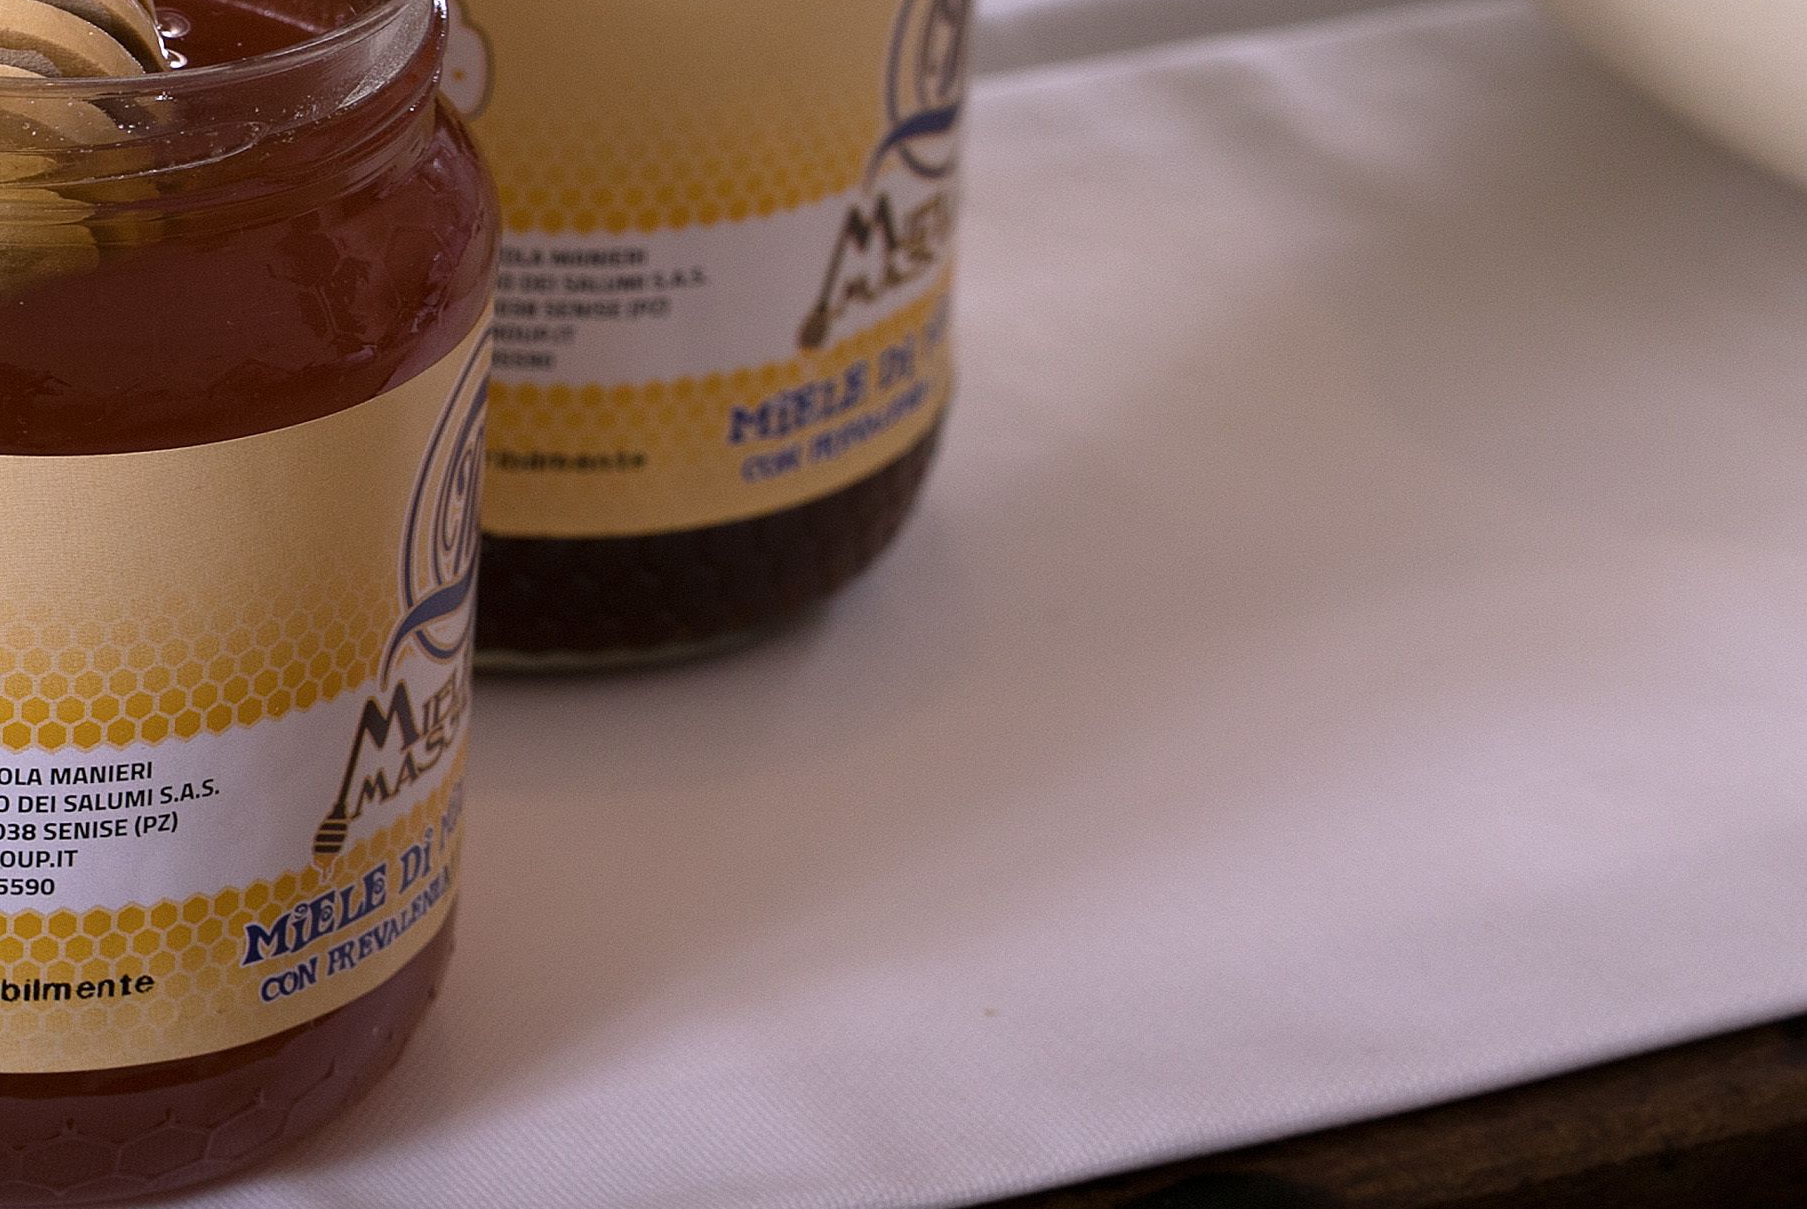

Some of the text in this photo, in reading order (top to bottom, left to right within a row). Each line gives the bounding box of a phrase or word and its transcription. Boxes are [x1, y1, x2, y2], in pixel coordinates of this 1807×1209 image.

[49, 760, 154, 786] MANIERI
[17, 794, 57, 814] DEI
[63, 788, 154, 814] SALUMI
[159, 778, 221, 805] S.A.S.
[43, 818, 129, 841] SENISE
[134, 811, 179, 837] (PZ)
[259, 954, 320, 1004] CON
